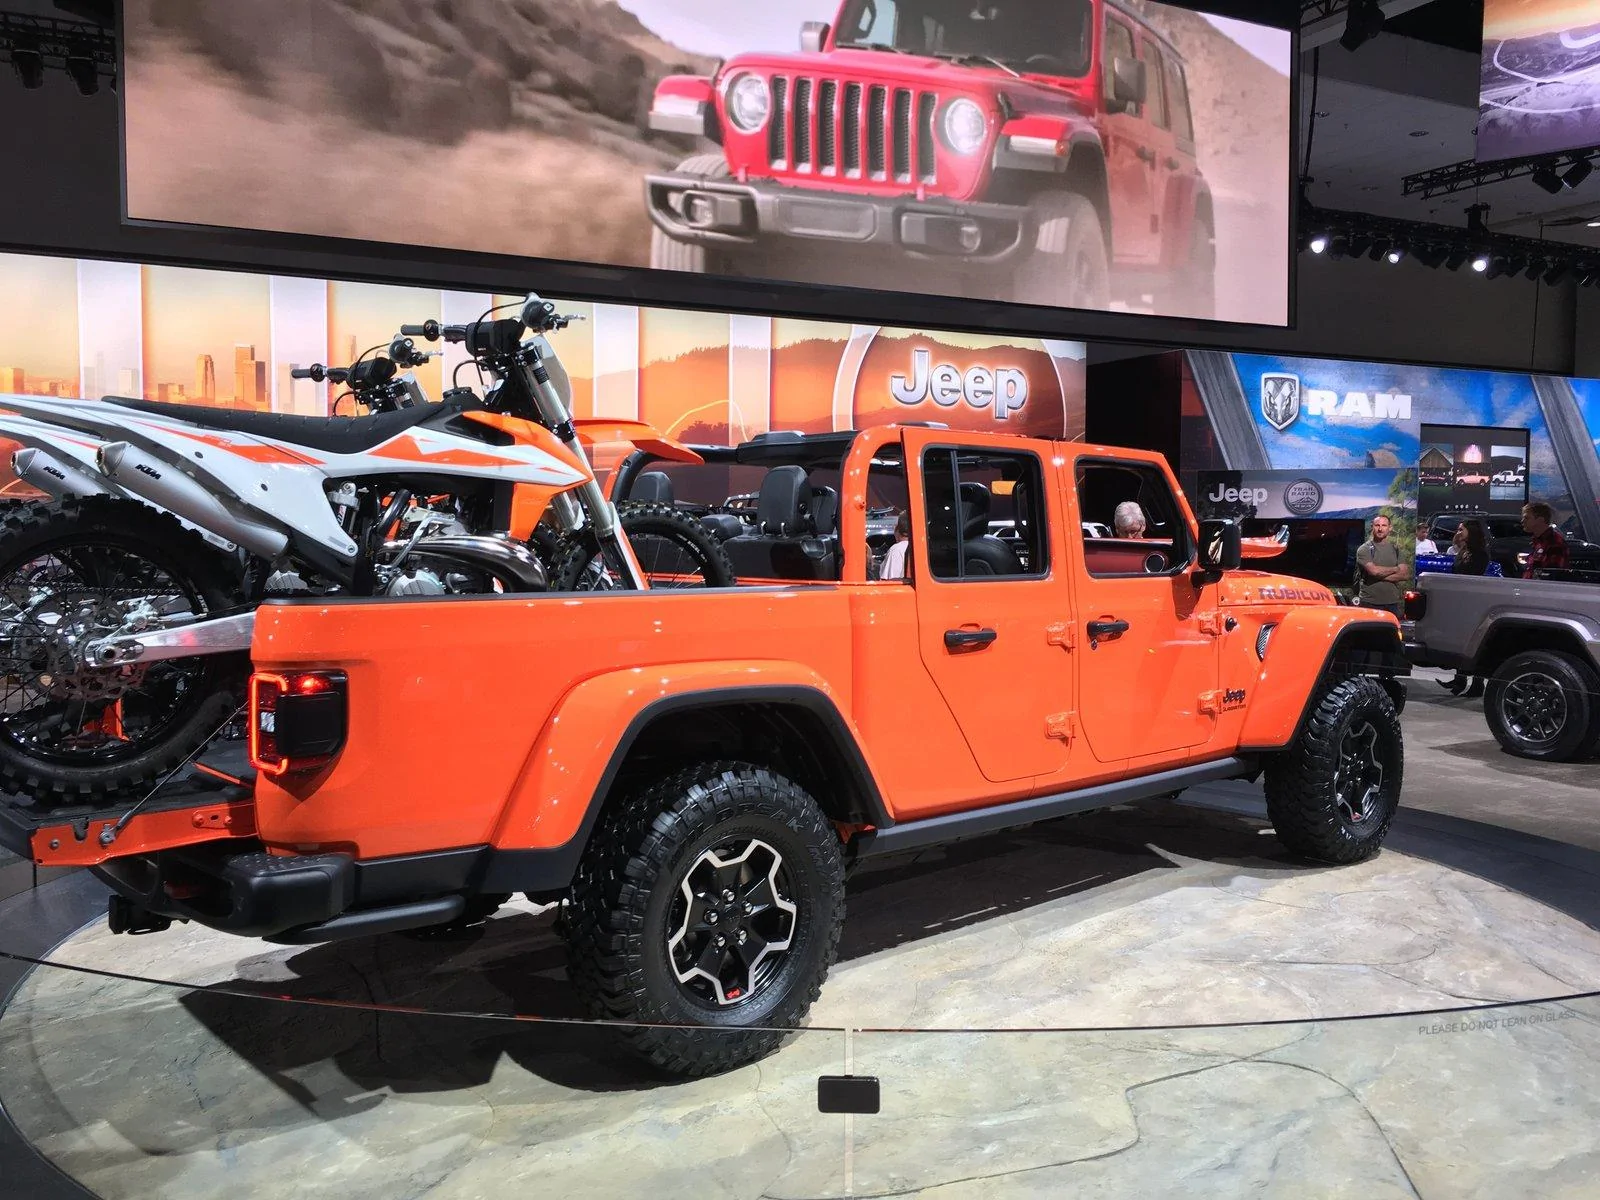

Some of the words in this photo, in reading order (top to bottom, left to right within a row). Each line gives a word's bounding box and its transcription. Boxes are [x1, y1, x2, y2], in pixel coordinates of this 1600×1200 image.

[891, 349, 1028, 419] Jeep
[1307, 389, 1412, 420] RAM
[43, 466, 65, 480] KTM
[135, 464, 161, 480] KTM
[1208, 483, 1268, 506] Jeep
[1258, 587, 1331, 601] RUBICON
[1223, 688, 1245, 703] Jeep
[1418, 1025, 1458, 1035] PLEASE
[1460, 1022, 1476, 1032] DO
[1478, 1019, 1498, 1030] NOT
[1501, 1016, 1527, 1028] LEAN
[1529, 1014, 1543, 1024] ON
[1545, 1010, 1575, 1022] GLASS
